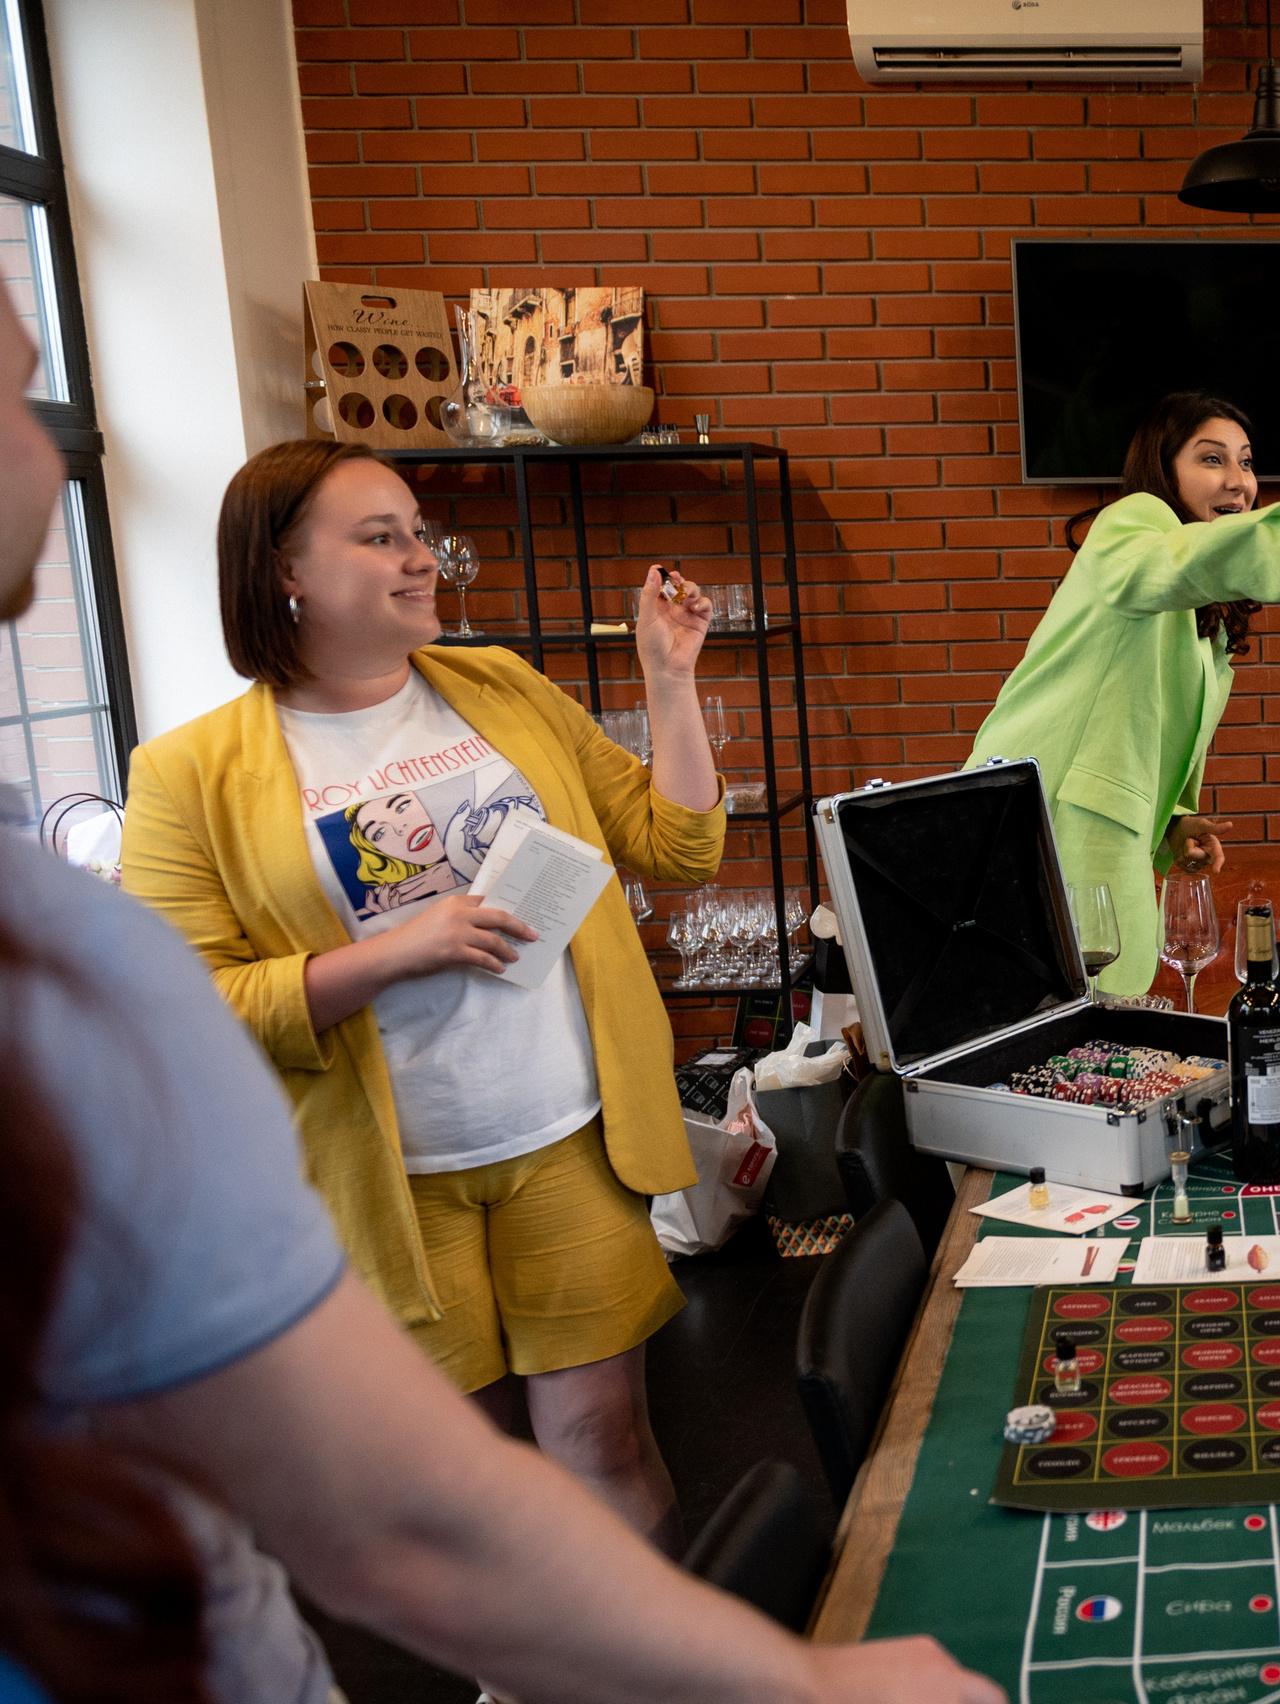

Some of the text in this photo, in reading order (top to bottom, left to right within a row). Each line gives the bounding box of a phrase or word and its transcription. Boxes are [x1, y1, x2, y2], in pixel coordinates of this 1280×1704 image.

[347, 326, 371, 334] CLASSY
[374, 328, 398, 336] PEOPLE
[416, 331, 443, 339] WASTED
[302, 781, 362, 811] ROY
[368, 735, 497, 791] LICHTENSTEIN
[1152, 1518, 1235, 1535] Мальбек
[1165, 1599, 1232, 1616] Сира
[1145, 1662, 1259, 1692] Каберне
